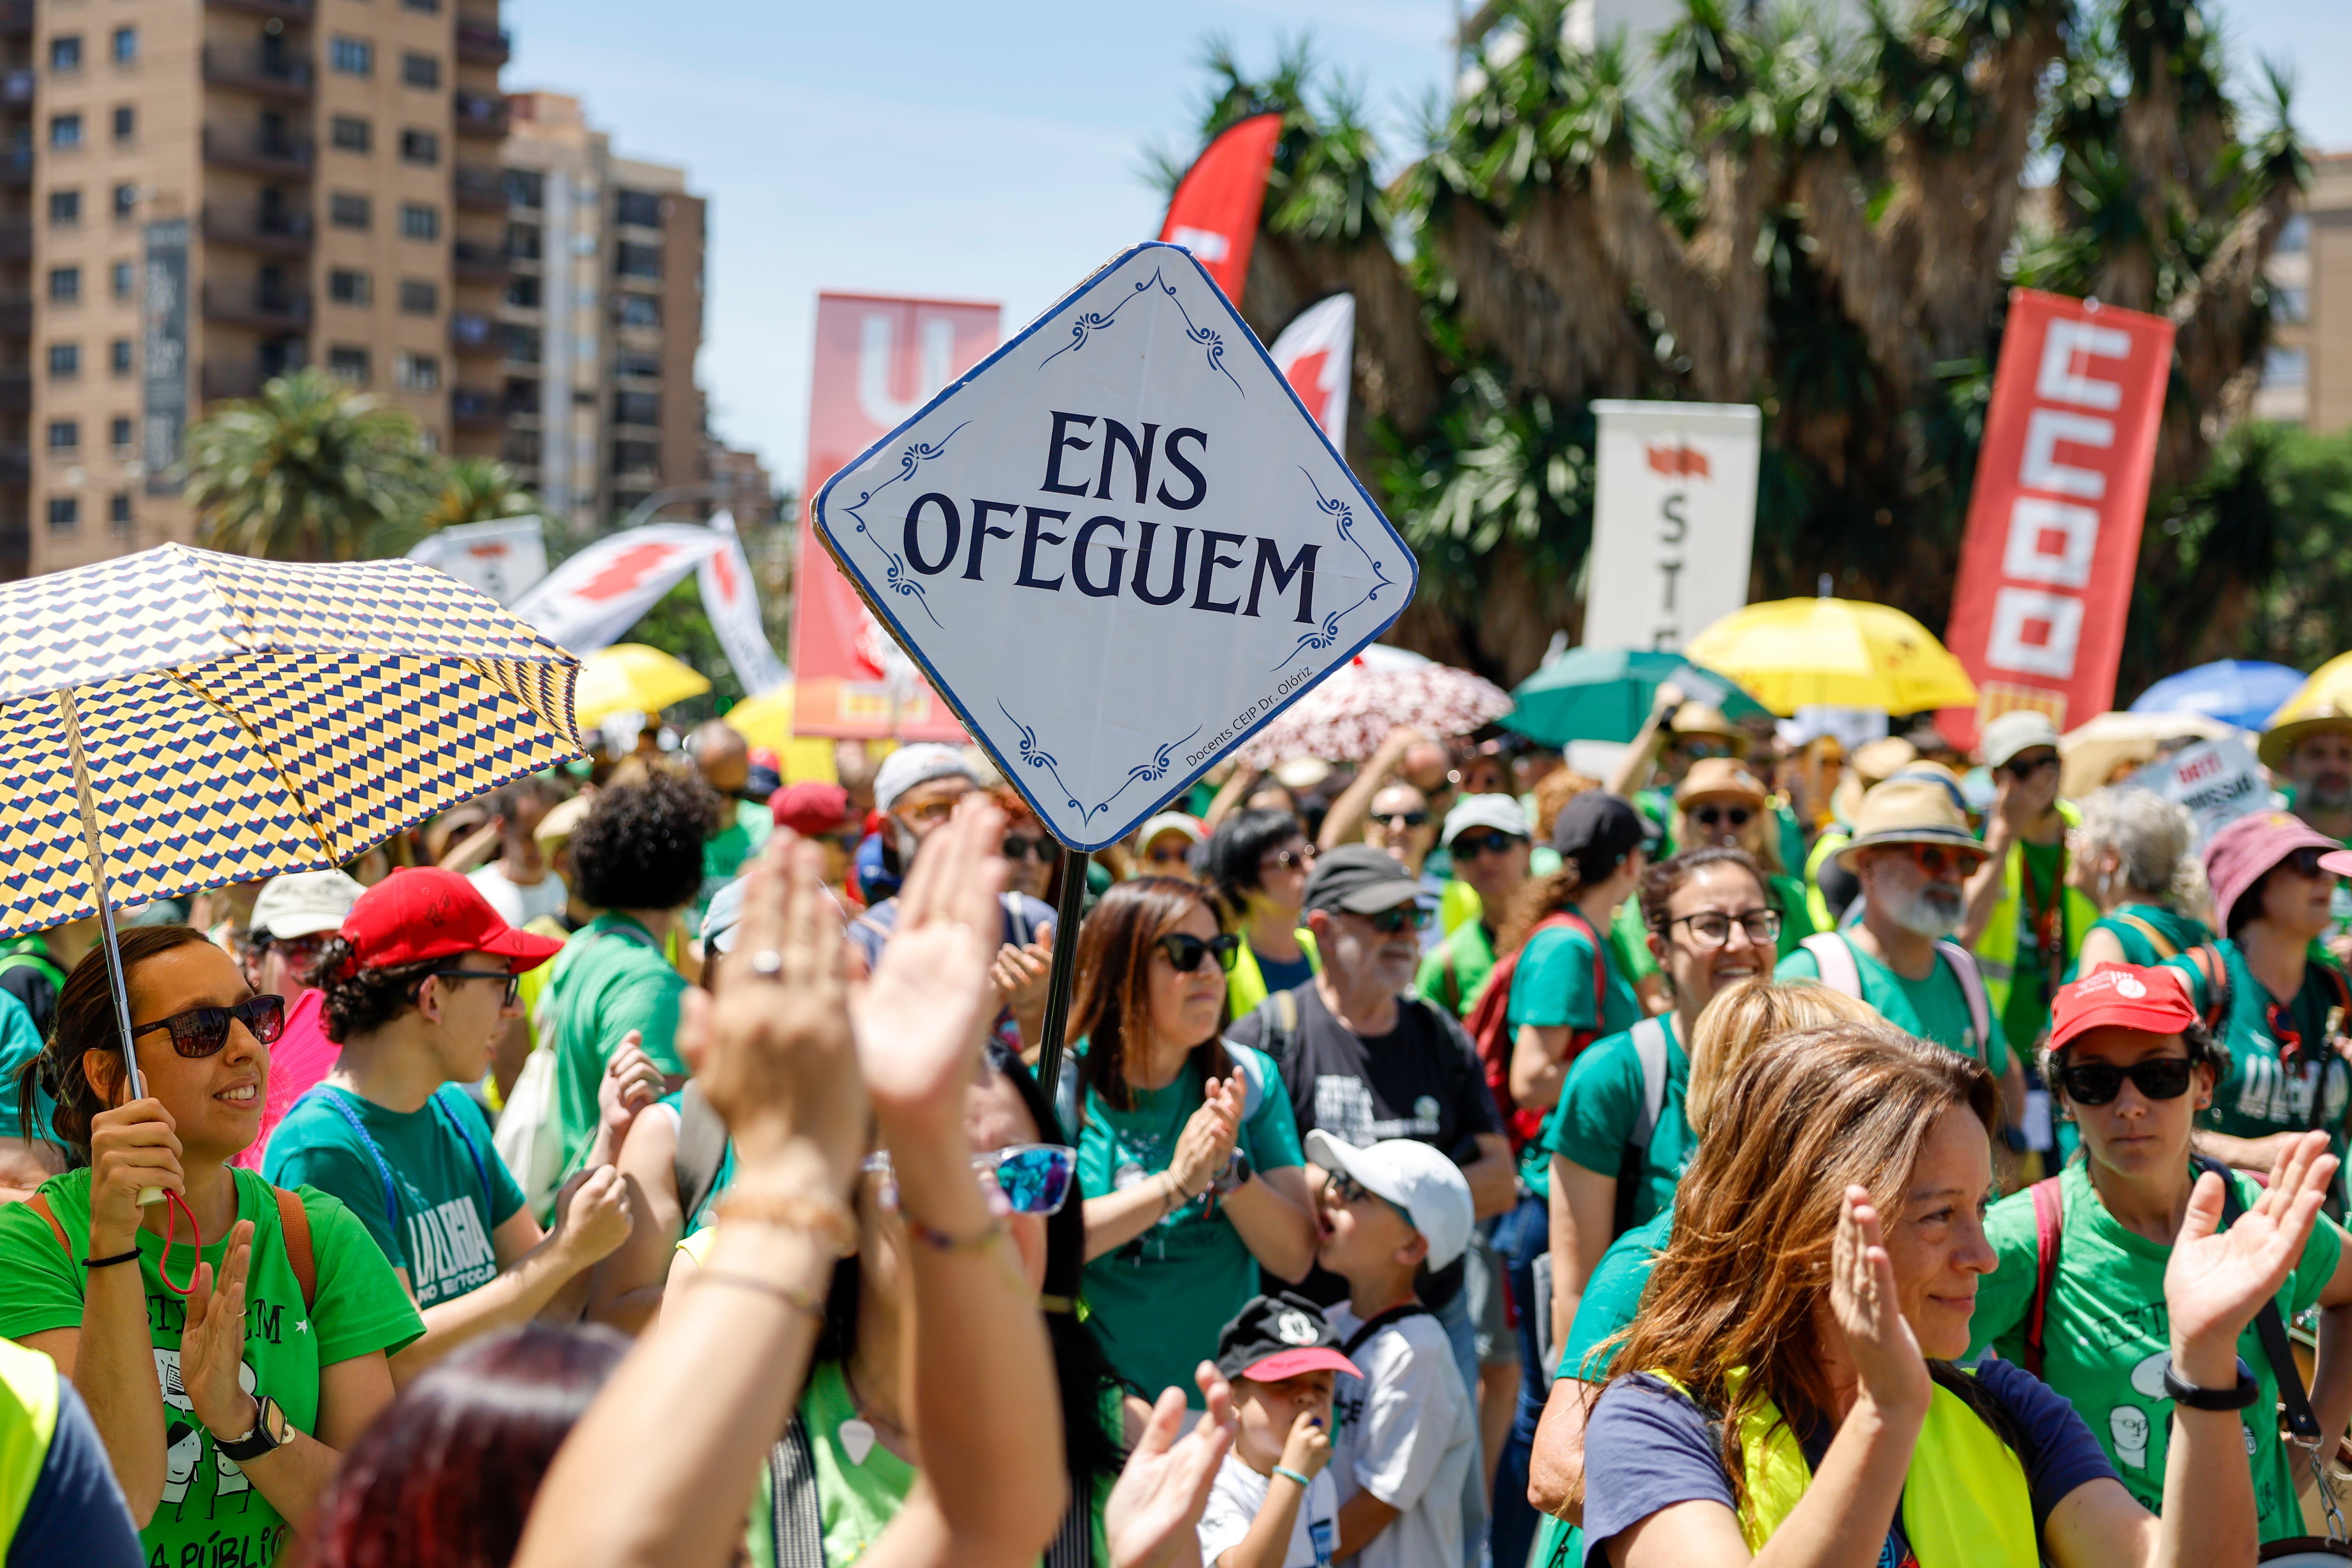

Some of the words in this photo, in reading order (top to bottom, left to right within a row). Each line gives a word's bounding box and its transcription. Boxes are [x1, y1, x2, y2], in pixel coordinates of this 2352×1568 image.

[857, 313, 956, 428] U
[1039, 410, 1208, 510] ENS
[1985, 317, 2131, 680] CCOO
[903, 493, 1322, 624] OFEGUEM
[1185, 728, 1233, 767] Docents
[1232, 706, 1256, 730] CEIP
[1258, 695, 1279, 710] Dr.
[1278, 666, 1312, 695] Olóriz
[417, 1283, 438, 1305] NO
